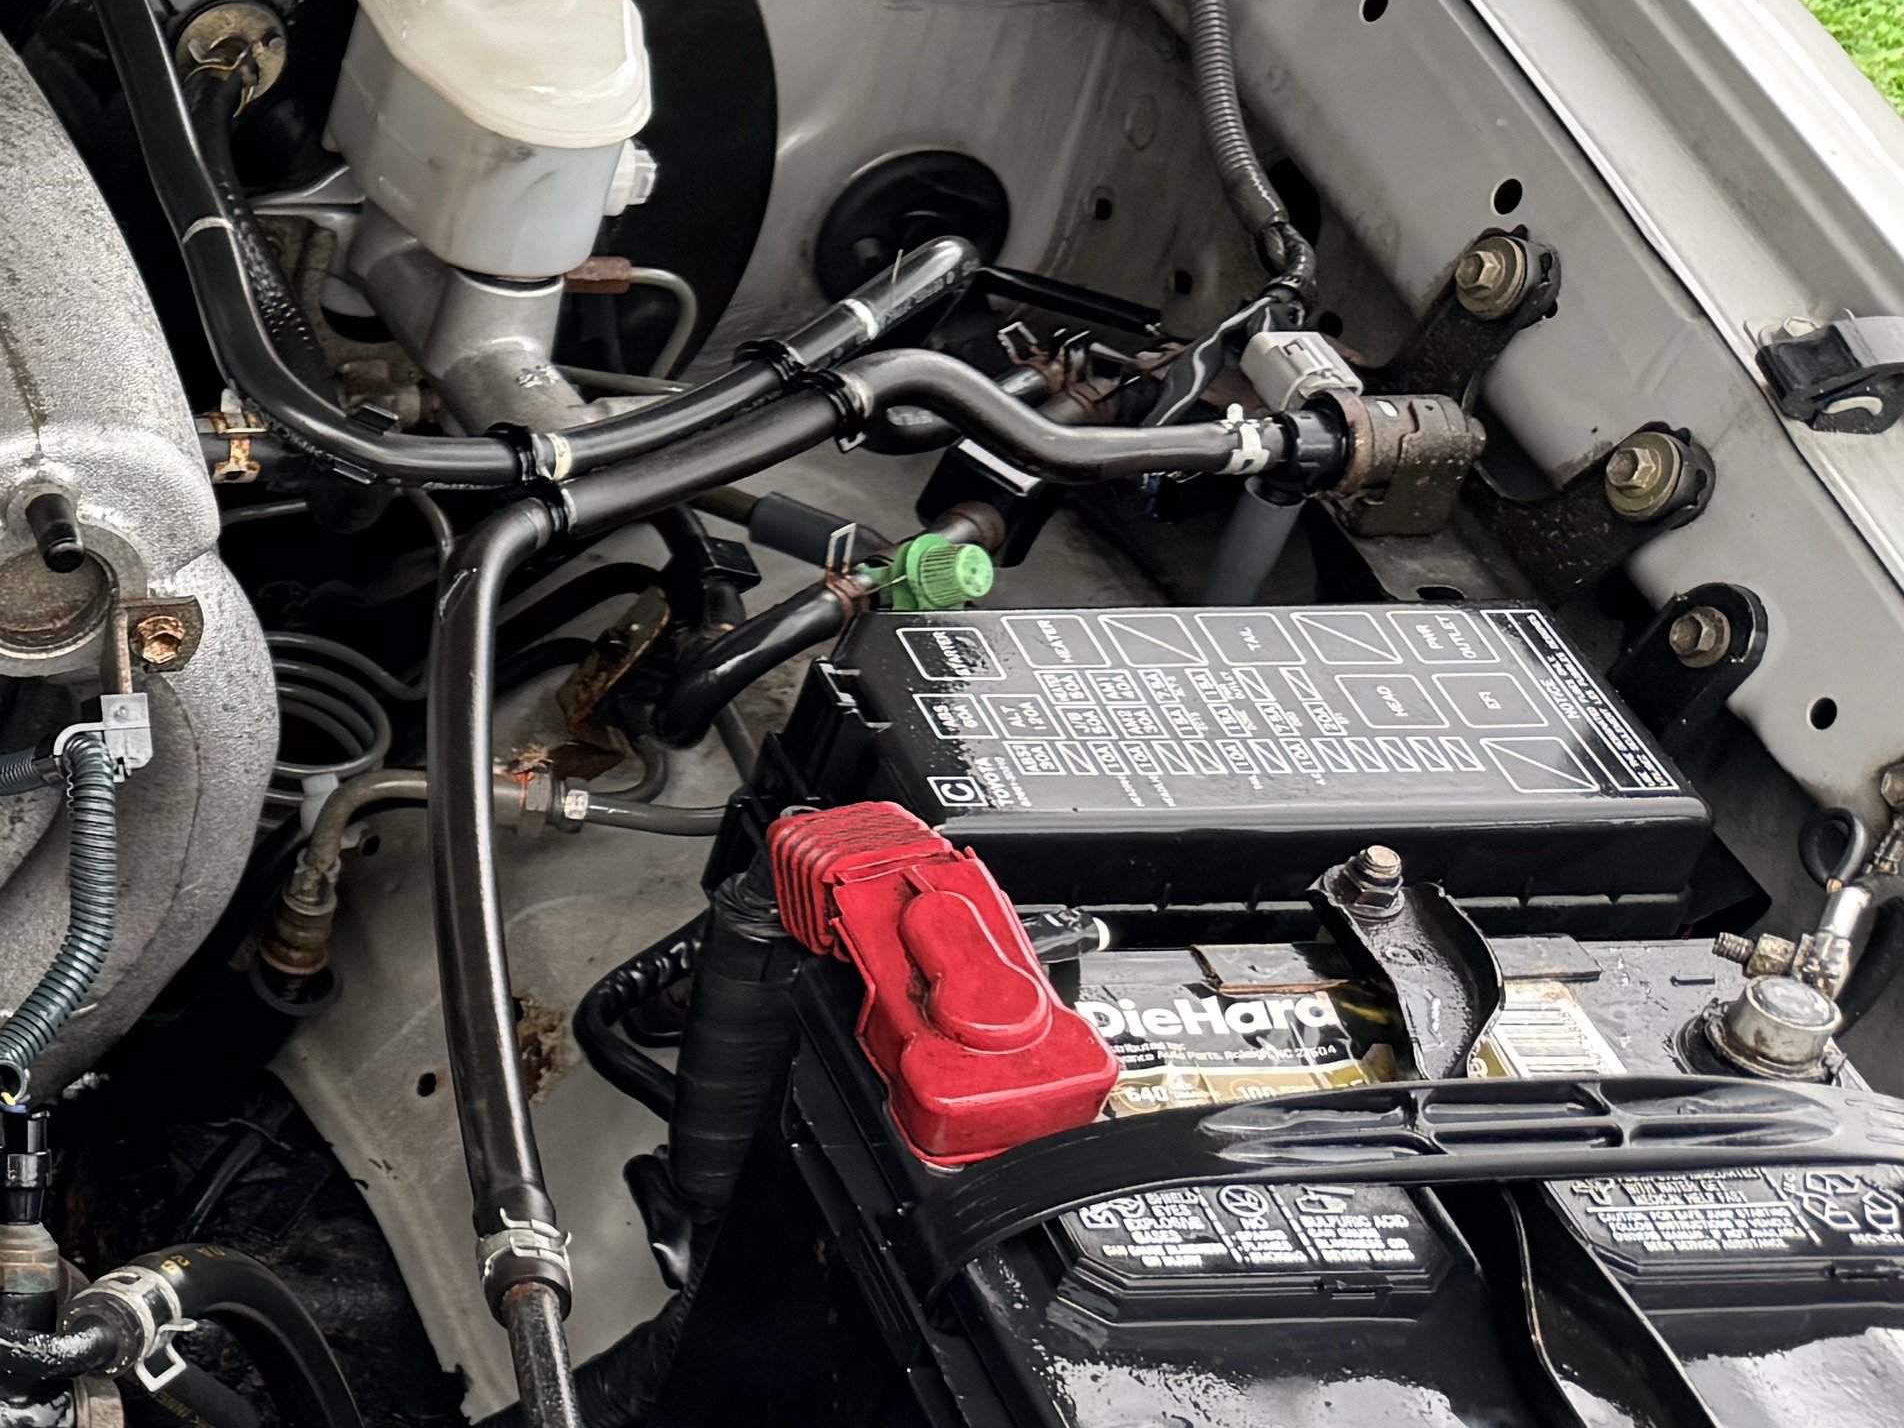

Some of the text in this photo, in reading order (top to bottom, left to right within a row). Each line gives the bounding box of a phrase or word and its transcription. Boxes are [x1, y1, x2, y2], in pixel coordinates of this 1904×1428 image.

[1036, 619, 1076, 664] HEATER
[1238, 626, 1262, 652] TAIL
[1415, 623, 1444, 650] PWR
[1434, 614, 1478, 660] OUTLET
[932, 630, 973, 677] STARTER
[1375, 686, 1409, 718] HEAD
[1477, 691, 1502, 710] EFI
[1540, 678, 1582, 720] NOTICE
[932, 703, 960, 733] ABS
[1000, 704, 1027, 728] ALT
[1018, 701, 1048, 731] 120A
[1095, 745, 1121, 770] 10A
[1126, 745, 1153, 770] 10A
[1224, 744, 1249, 769] 10A
[1289, 743, 1314, 768] 10A
[942, 783, 976, 802] C
[974, 757, 1015, 807] TOYOTA
[1075, 990, 1342, 1036] DieHard
[1157, 1051, 1188, 1063] Auto
[1124, 1084, 1170, 1103] 640
[1622, 1181, 1655, 1194] WITH
[1699, 1179, 1728, 1192] GET
[1685, 1191, 1717, 1205] HELP
[1151, 1204, 1193, 1217] EYES
[1239, 1216, 1269, 1229] NO
[1373, 1214, 1410, 1228] ACID
[1650, 1210, 1672, 1223] FOR
[1734, 1207, 1793, 1220] STARTING
[1123, 1216, 1206, 1231] EXPLOSIVE
[1131, 1230, 1184, 1244] GASES
